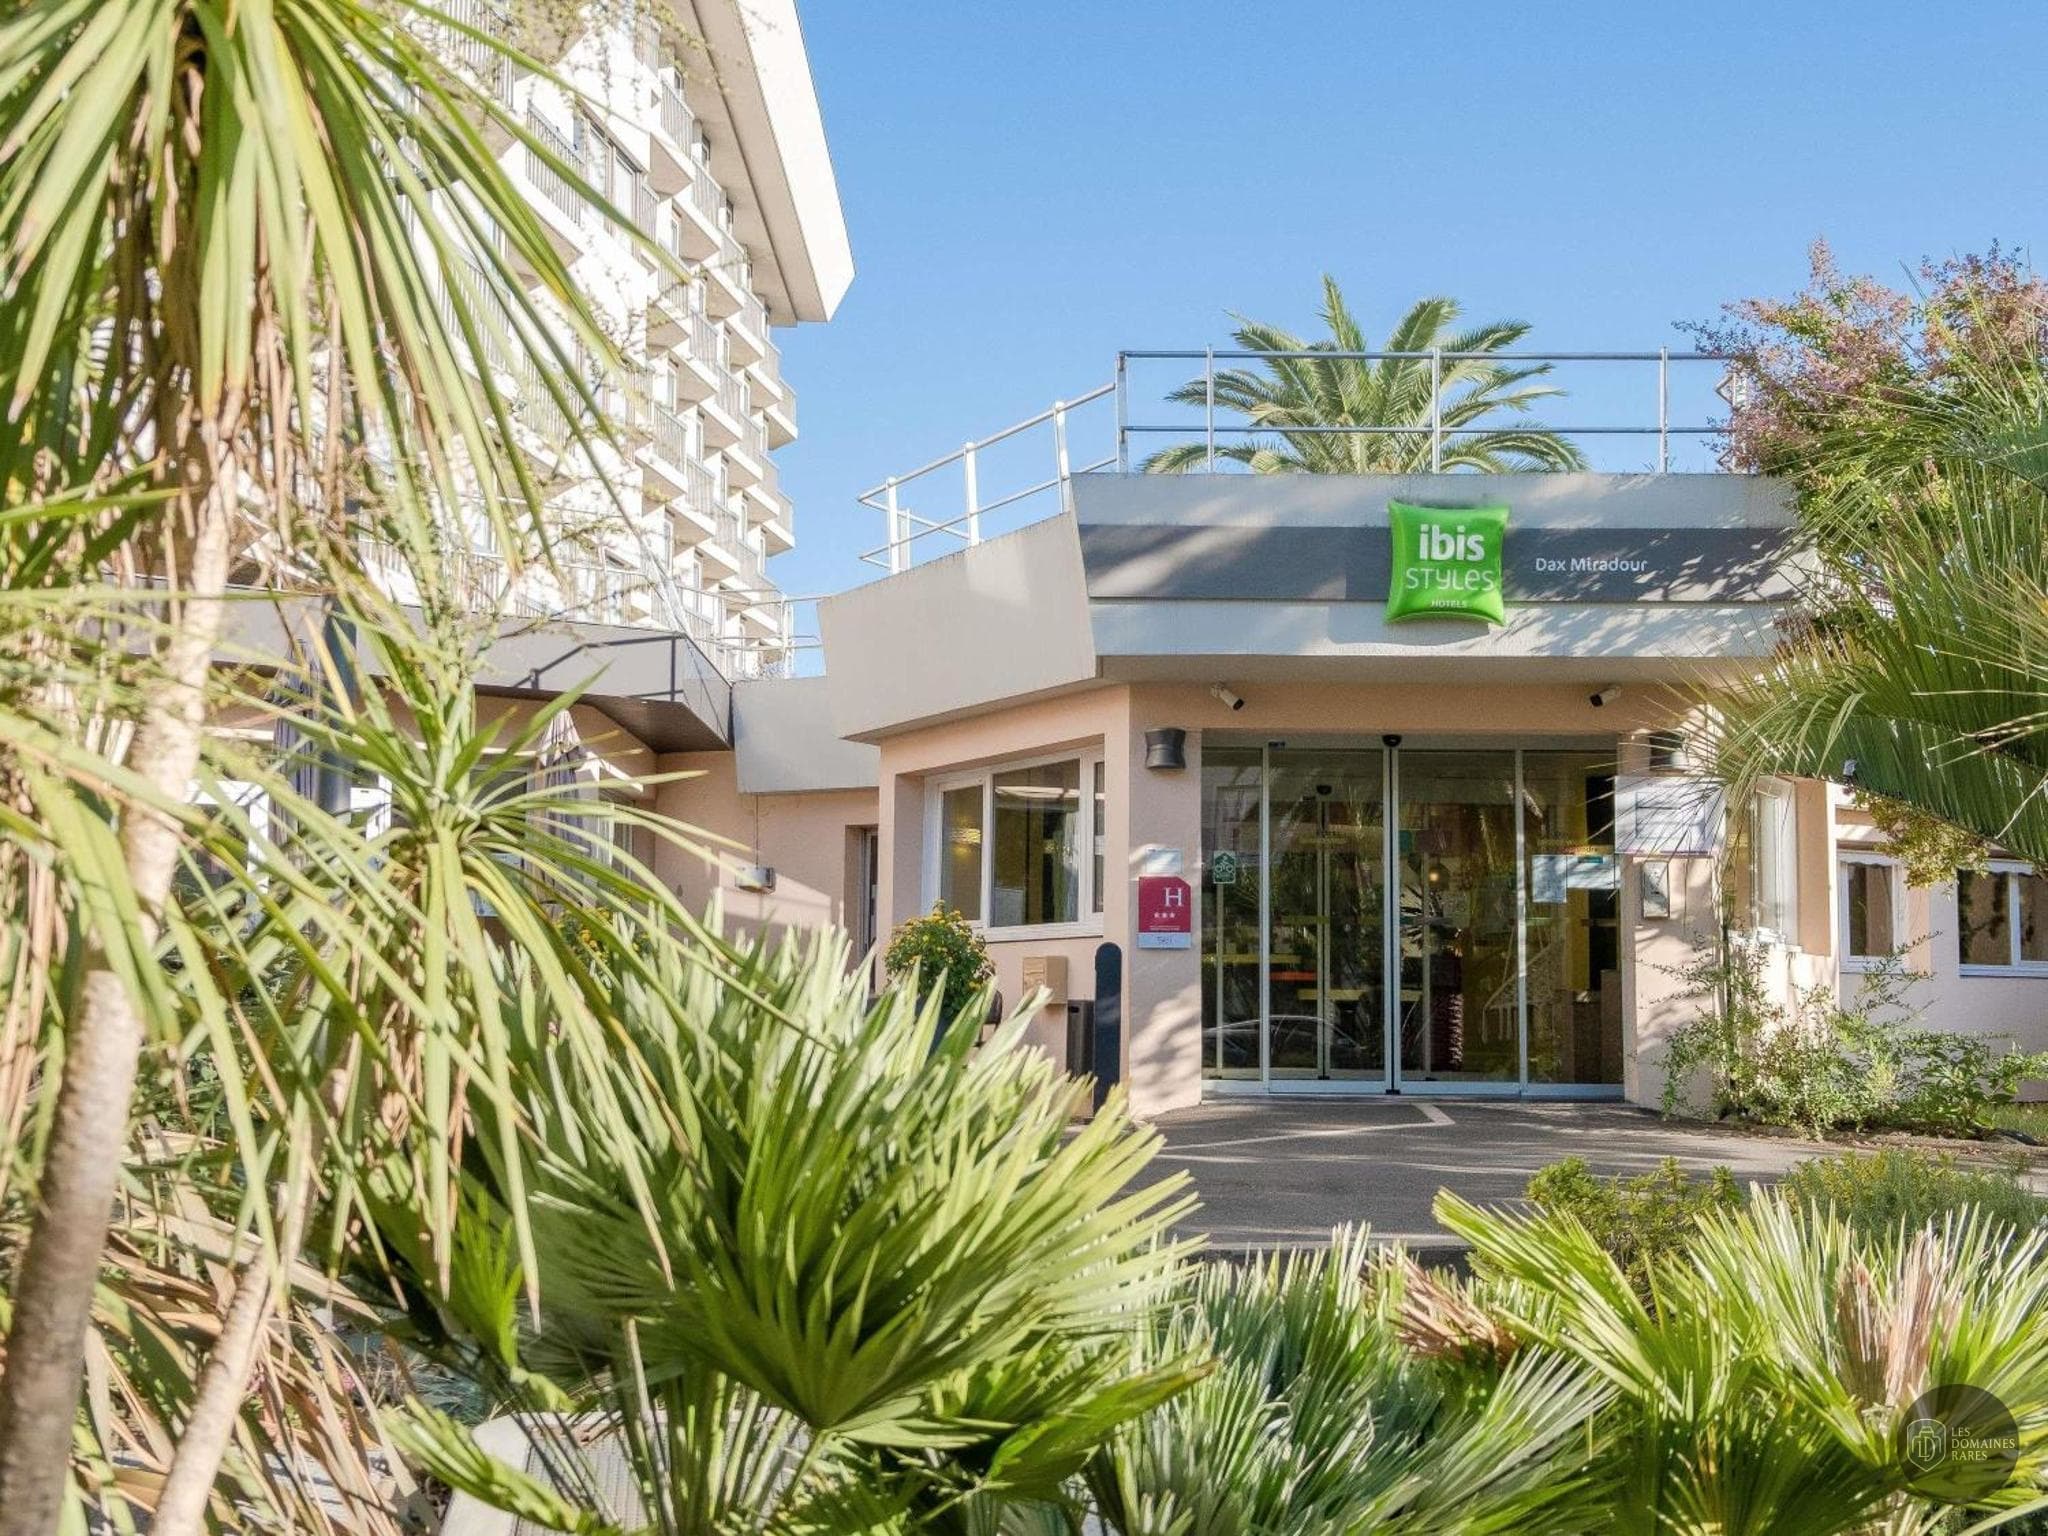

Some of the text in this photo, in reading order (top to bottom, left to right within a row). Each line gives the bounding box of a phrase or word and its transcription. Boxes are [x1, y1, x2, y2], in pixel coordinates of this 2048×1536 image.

[1419, 523, 1485, 561] ibis
[1535, 557, 1648, 571] Dax Miradour
[1431, 599, 1468, 609] HOTELS
[1164, 886, 1184, 907] H
